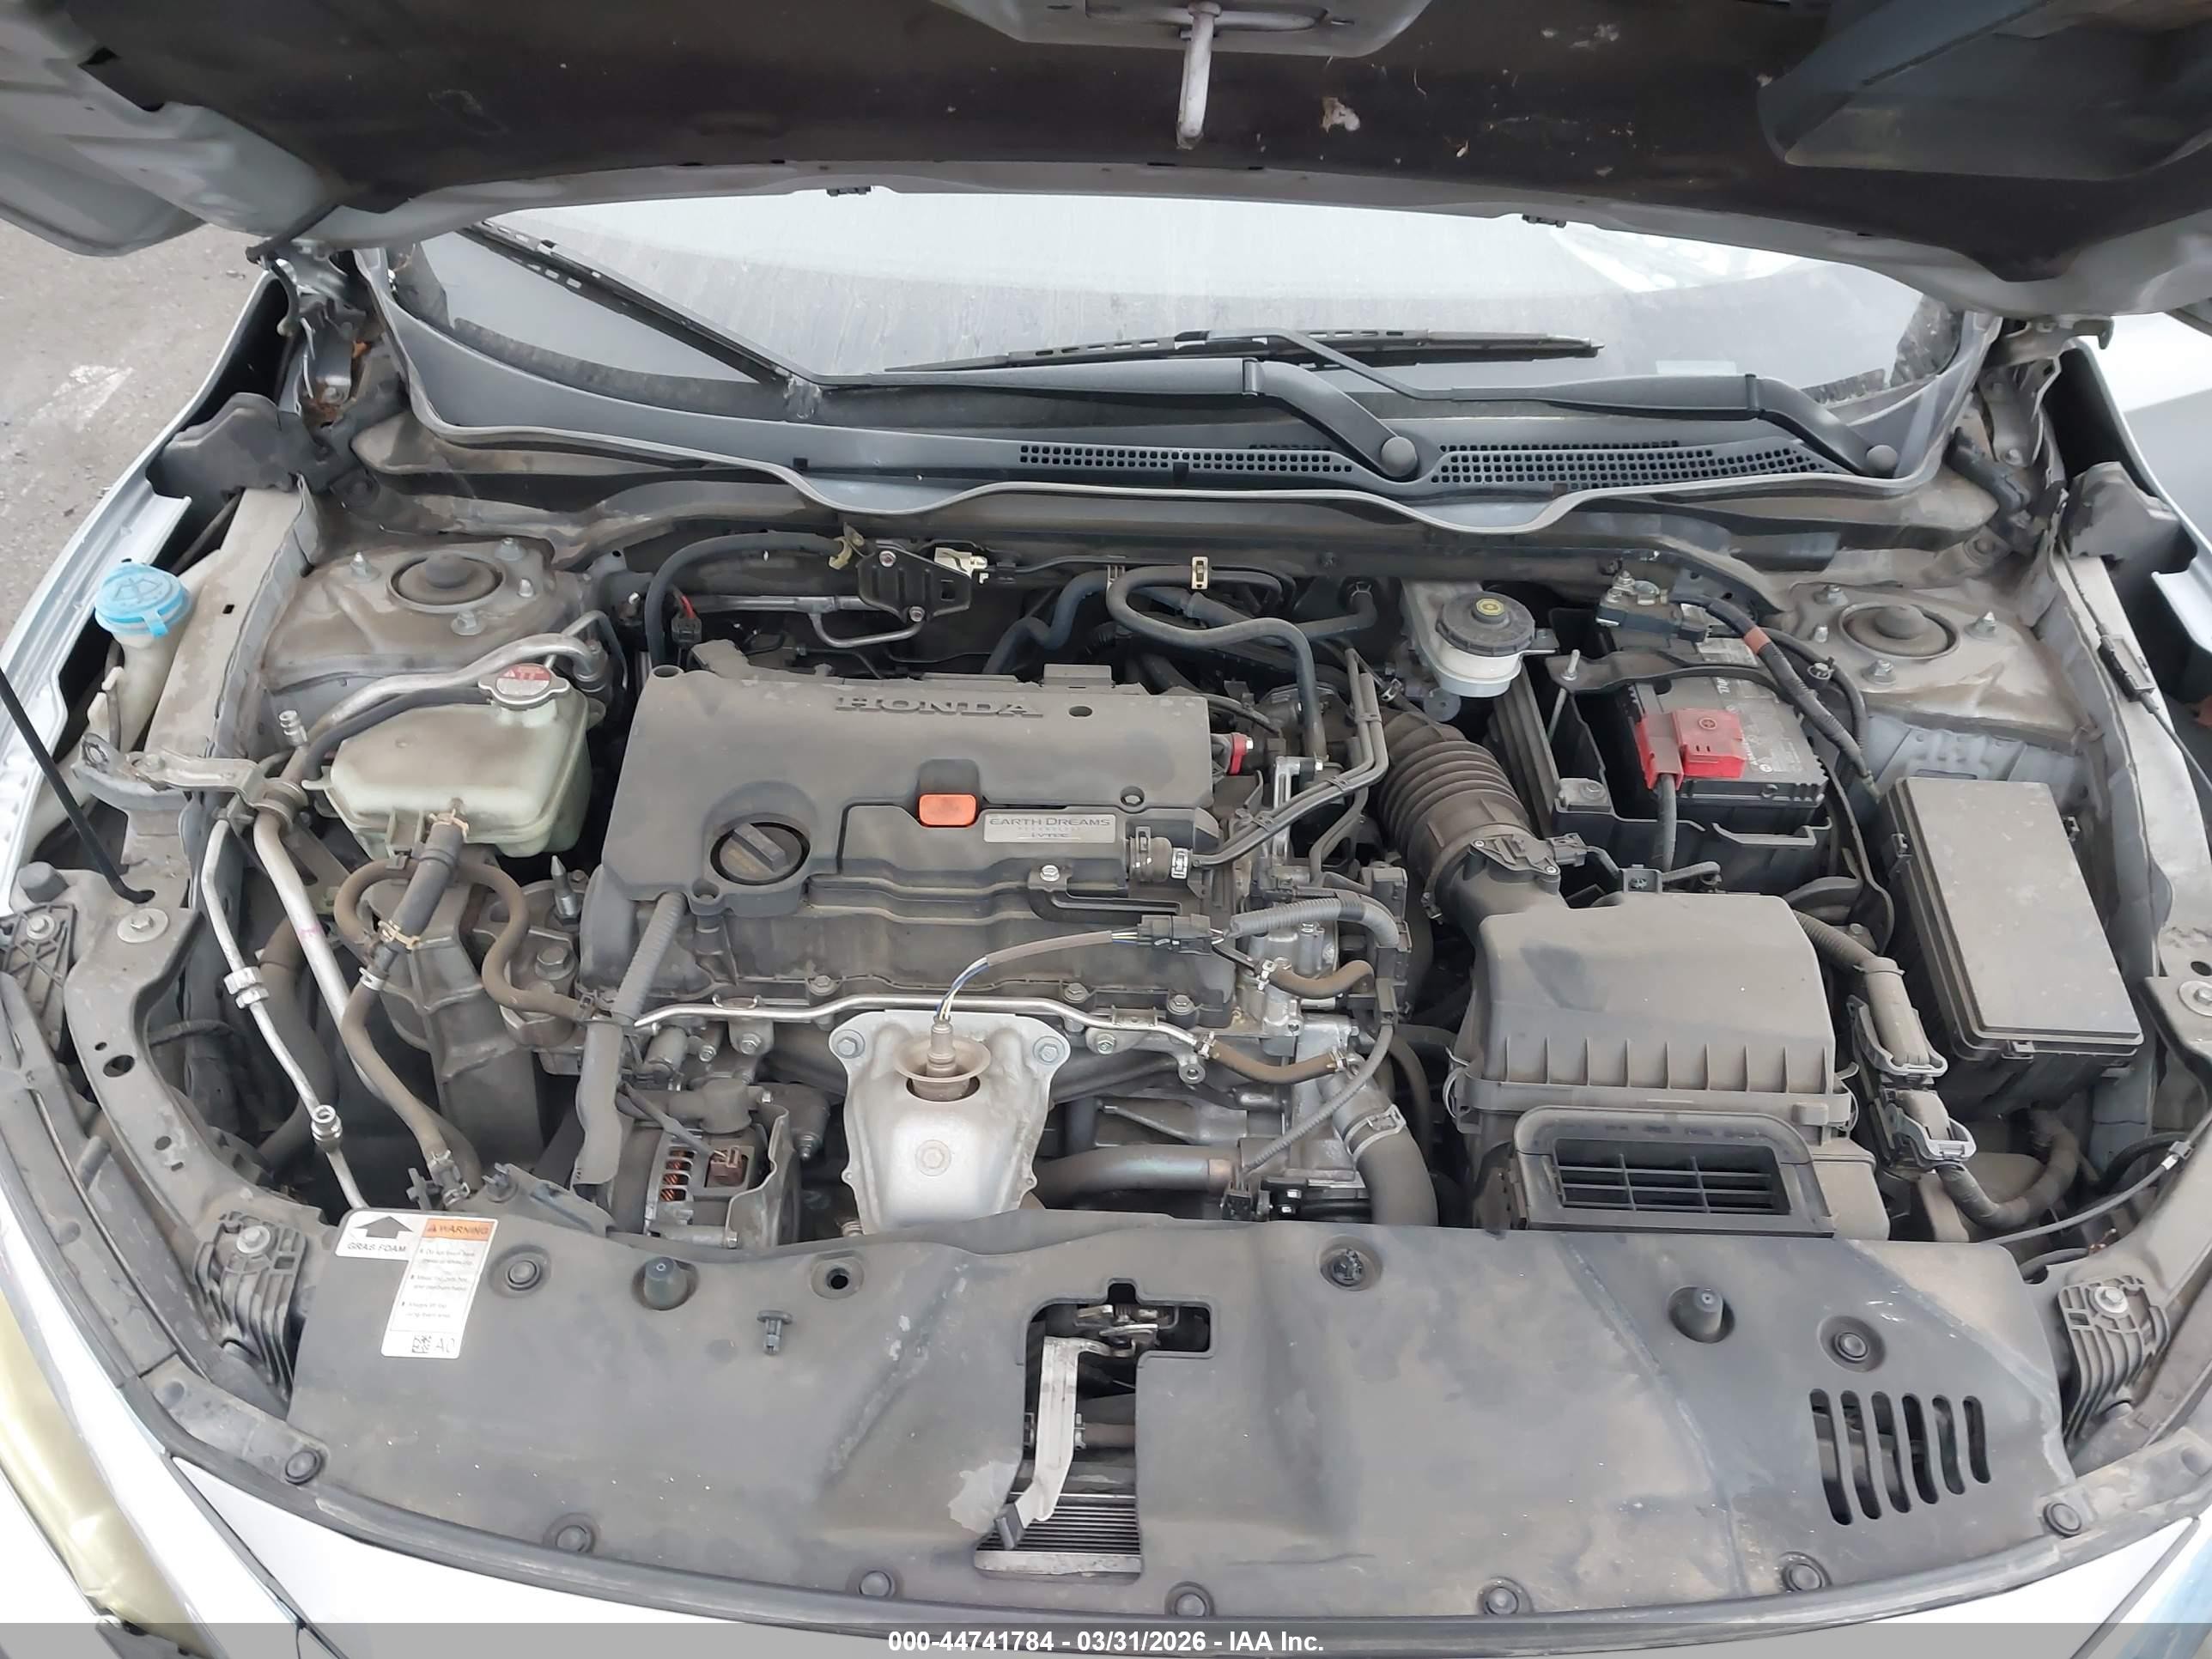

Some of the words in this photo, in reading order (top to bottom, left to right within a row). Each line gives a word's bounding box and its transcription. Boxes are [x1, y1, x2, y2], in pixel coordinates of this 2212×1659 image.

[835, 696, 1043, 718] HONDA
[1046, 817, 1110, 826] DREAMS
[439, 1224, 489, 1235] WARNING
[347, 1243, 376, 1251] GRAS
